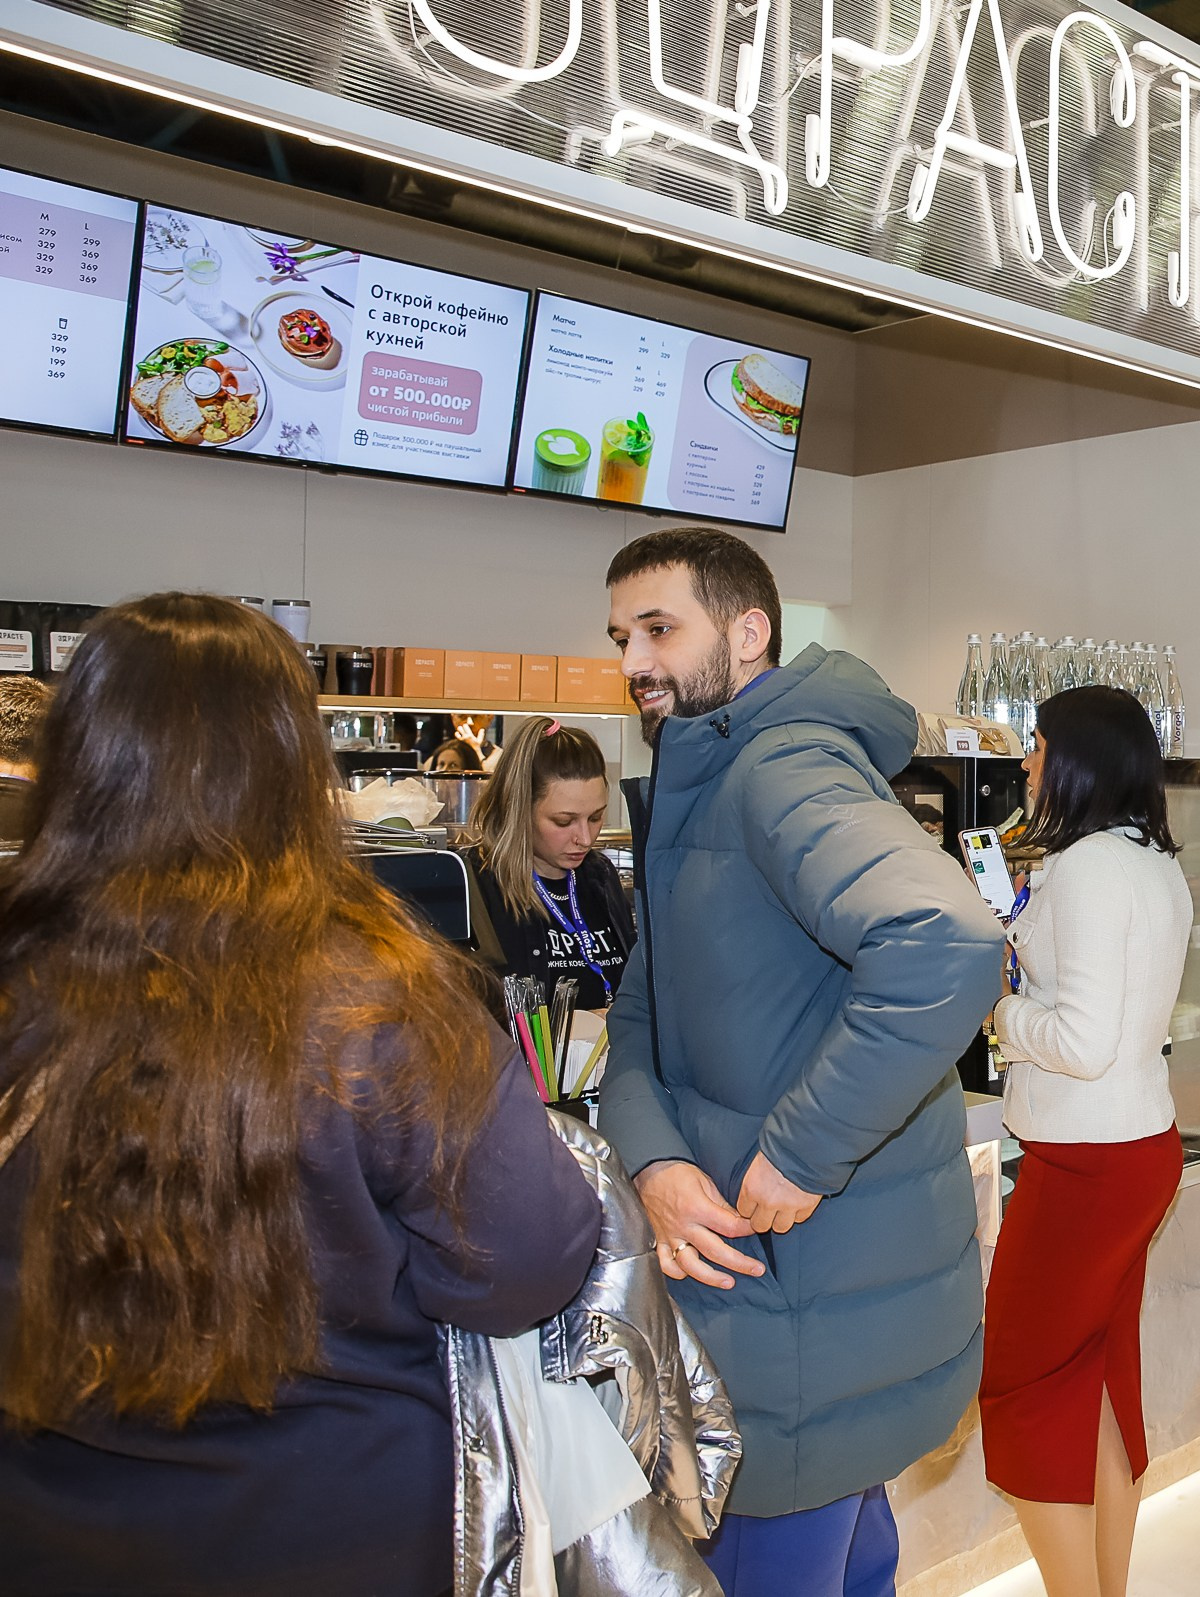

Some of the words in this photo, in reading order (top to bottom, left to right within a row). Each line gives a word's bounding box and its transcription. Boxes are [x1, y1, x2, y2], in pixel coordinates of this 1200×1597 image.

[40, 213, 49, 221] M
[39, 227, 56, 237] 279
[83, 237, 101, 247] 299
[37, 240, 55, 250] 329
[82, 250, 99, 259] 369
[36, 253, 54, 262] 329
[80, 262, 98, 272] 369
[35, 265, 53, 275] 329
[79, 275, 97, 284] 369
[371, 284, 432, 310] Открой
[438, 302, 509, 326] кофейню
[368, 309, 377, 319] с
[382, 311, 467, 337] авторской
[552, 314, 576, 326] Матча
[51, 333, 68, 342] 329
[366, 329, 424, 350] кухней
[51, 345, 67, 354] 199
[548, 344, 584, 359] Холодные
[585, 354, 614, 366] напитки
[50, 358, 66, 366] 199
[47, 370, 65, 378] 369
[371, 366, 448, 388] зарабатывай
[369, 385, 389, 398] от
[394, 386, 472, 411] 500.000₽
[367, 403, 409, 417] чистой
[412, 409, 463, 426] прибыли
[372, 431, 401, 442] Подарок
[1173, 711, 1182, 742] Vorgol
[547, 960, 568, 968] ЖНЕЕ
